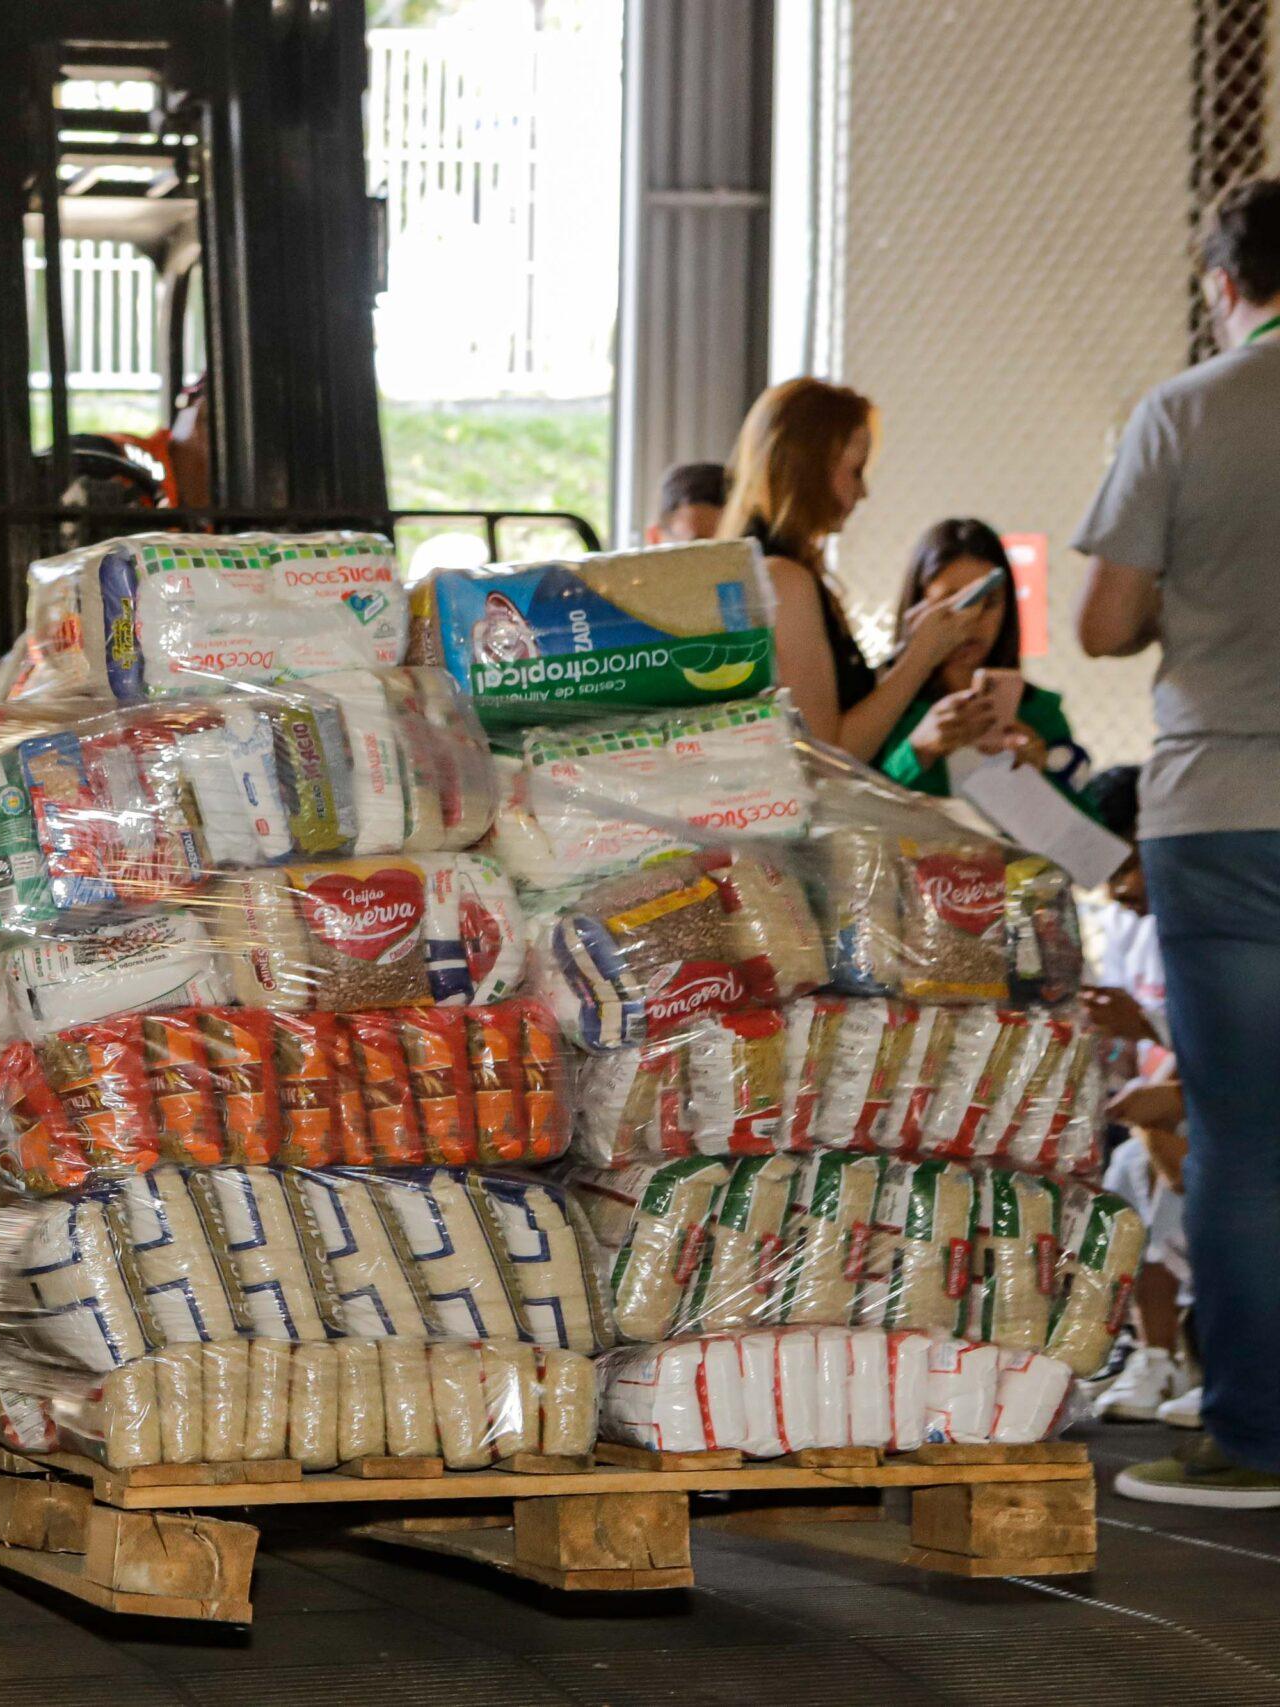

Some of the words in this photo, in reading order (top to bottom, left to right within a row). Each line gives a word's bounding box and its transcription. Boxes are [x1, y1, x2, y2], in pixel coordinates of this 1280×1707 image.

[170, 651, 274, 674] DOCESUC
[554, 684, 575, 700] de
[578, 678, 627, 695] Cestas
[342, 888, 385, 908] Feijão
[313, 900, 417, 936] Reserva
